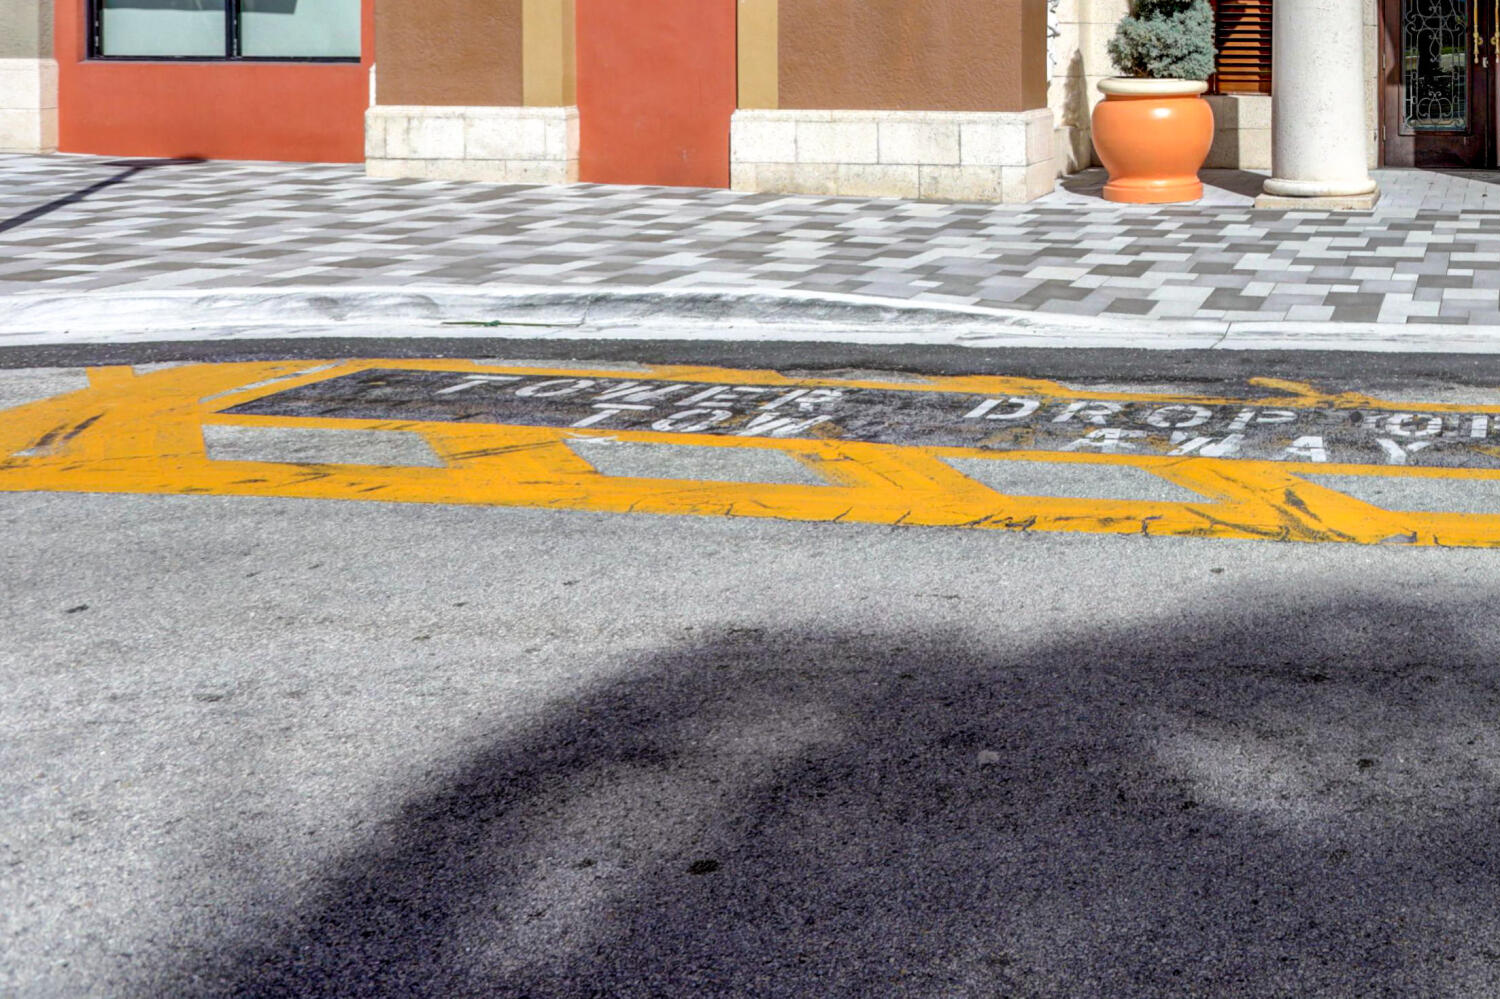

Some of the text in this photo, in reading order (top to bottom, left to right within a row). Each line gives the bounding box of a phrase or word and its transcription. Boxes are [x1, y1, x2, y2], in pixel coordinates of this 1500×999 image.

[436, 375, 844, 412] TOWER
[963, 398, 1299, 430] DROP
[571, 402, 833, 437] TOW
[1060, 427, 1433, 465] AWAY
